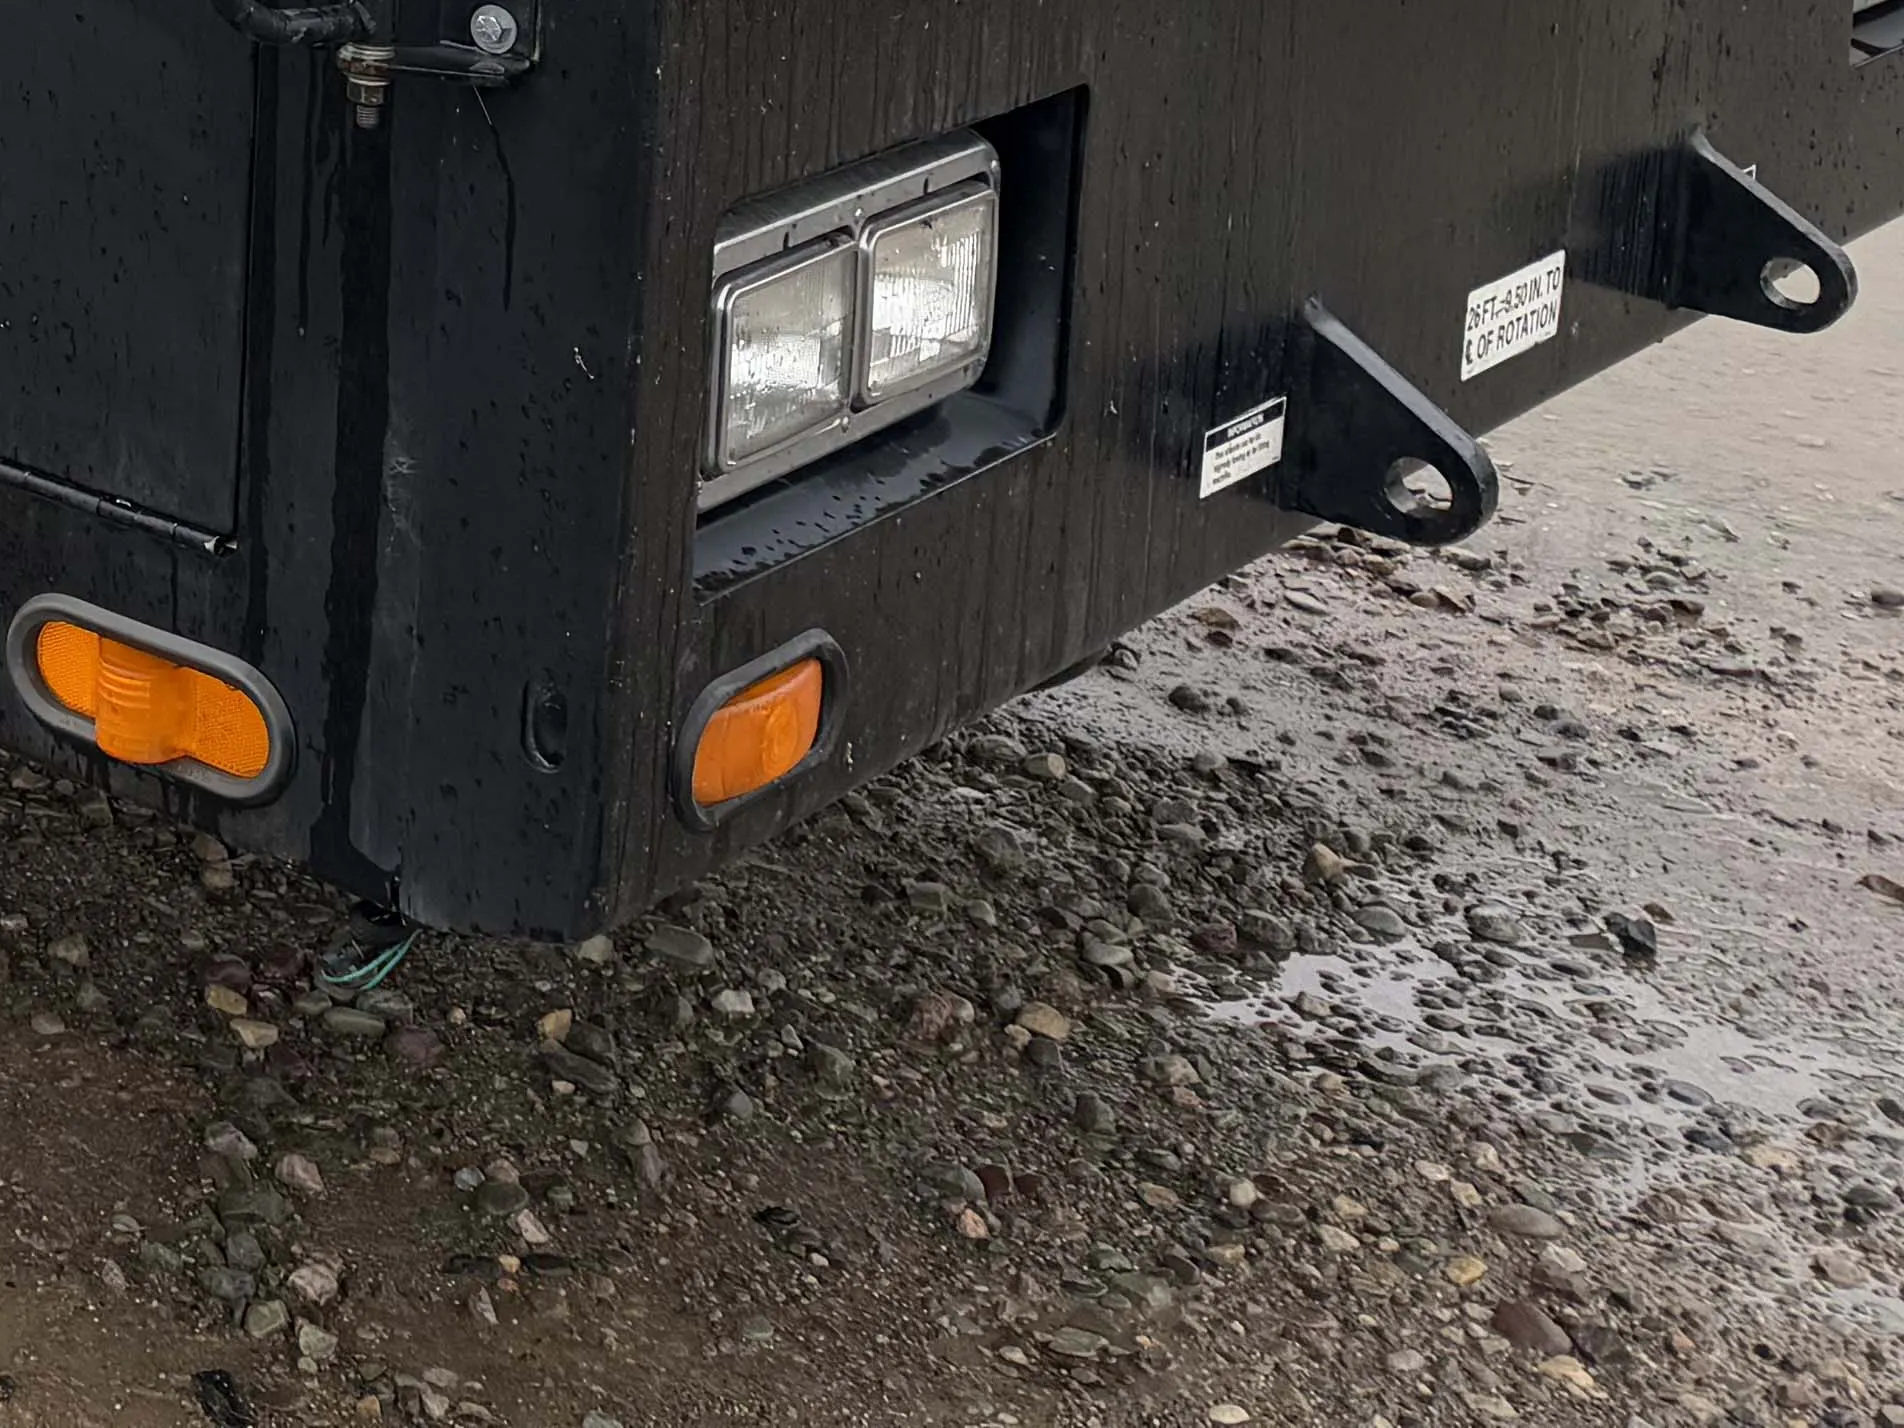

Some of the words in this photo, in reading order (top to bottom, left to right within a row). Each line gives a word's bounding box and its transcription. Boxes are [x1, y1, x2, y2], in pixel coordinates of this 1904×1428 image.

[1547, 266, 1561, 295] TO
[1477, 330, 1494, 360] OF
[1496, 299, 1558, 351] ROTATION
